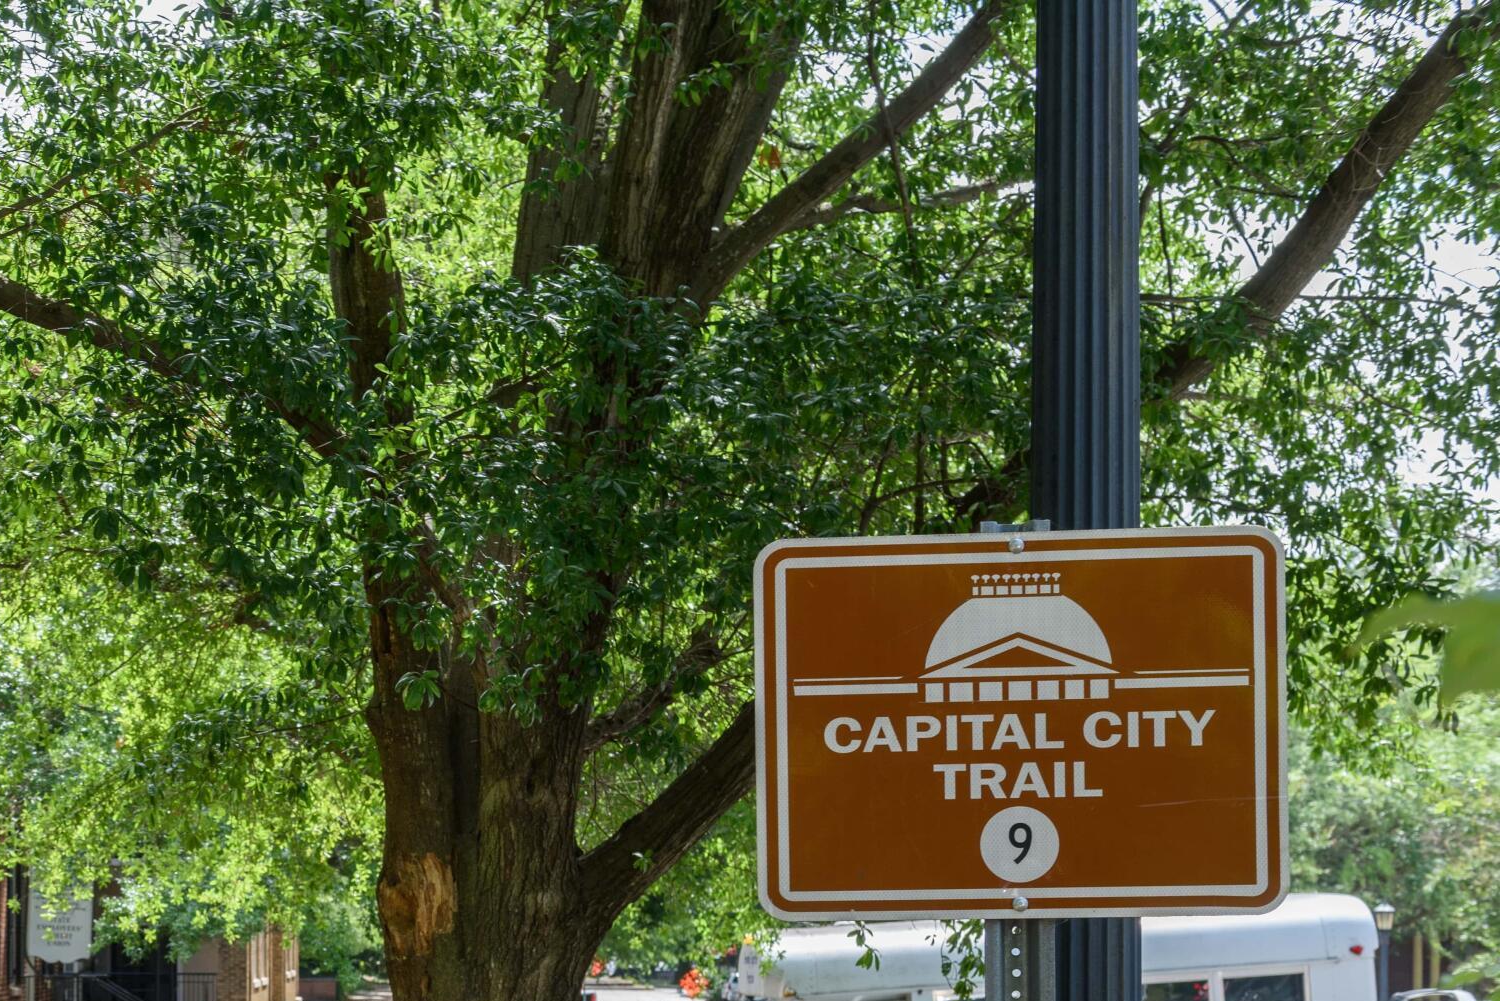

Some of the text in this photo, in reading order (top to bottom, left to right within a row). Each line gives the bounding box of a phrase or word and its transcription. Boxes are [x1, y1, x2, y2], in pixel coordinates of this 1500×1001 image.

[824, 710, 1215, 753] CAPITAL CITY
[934, 762, 1102, 799] TRAIL
[1009, 823, 1032, 863] 9
